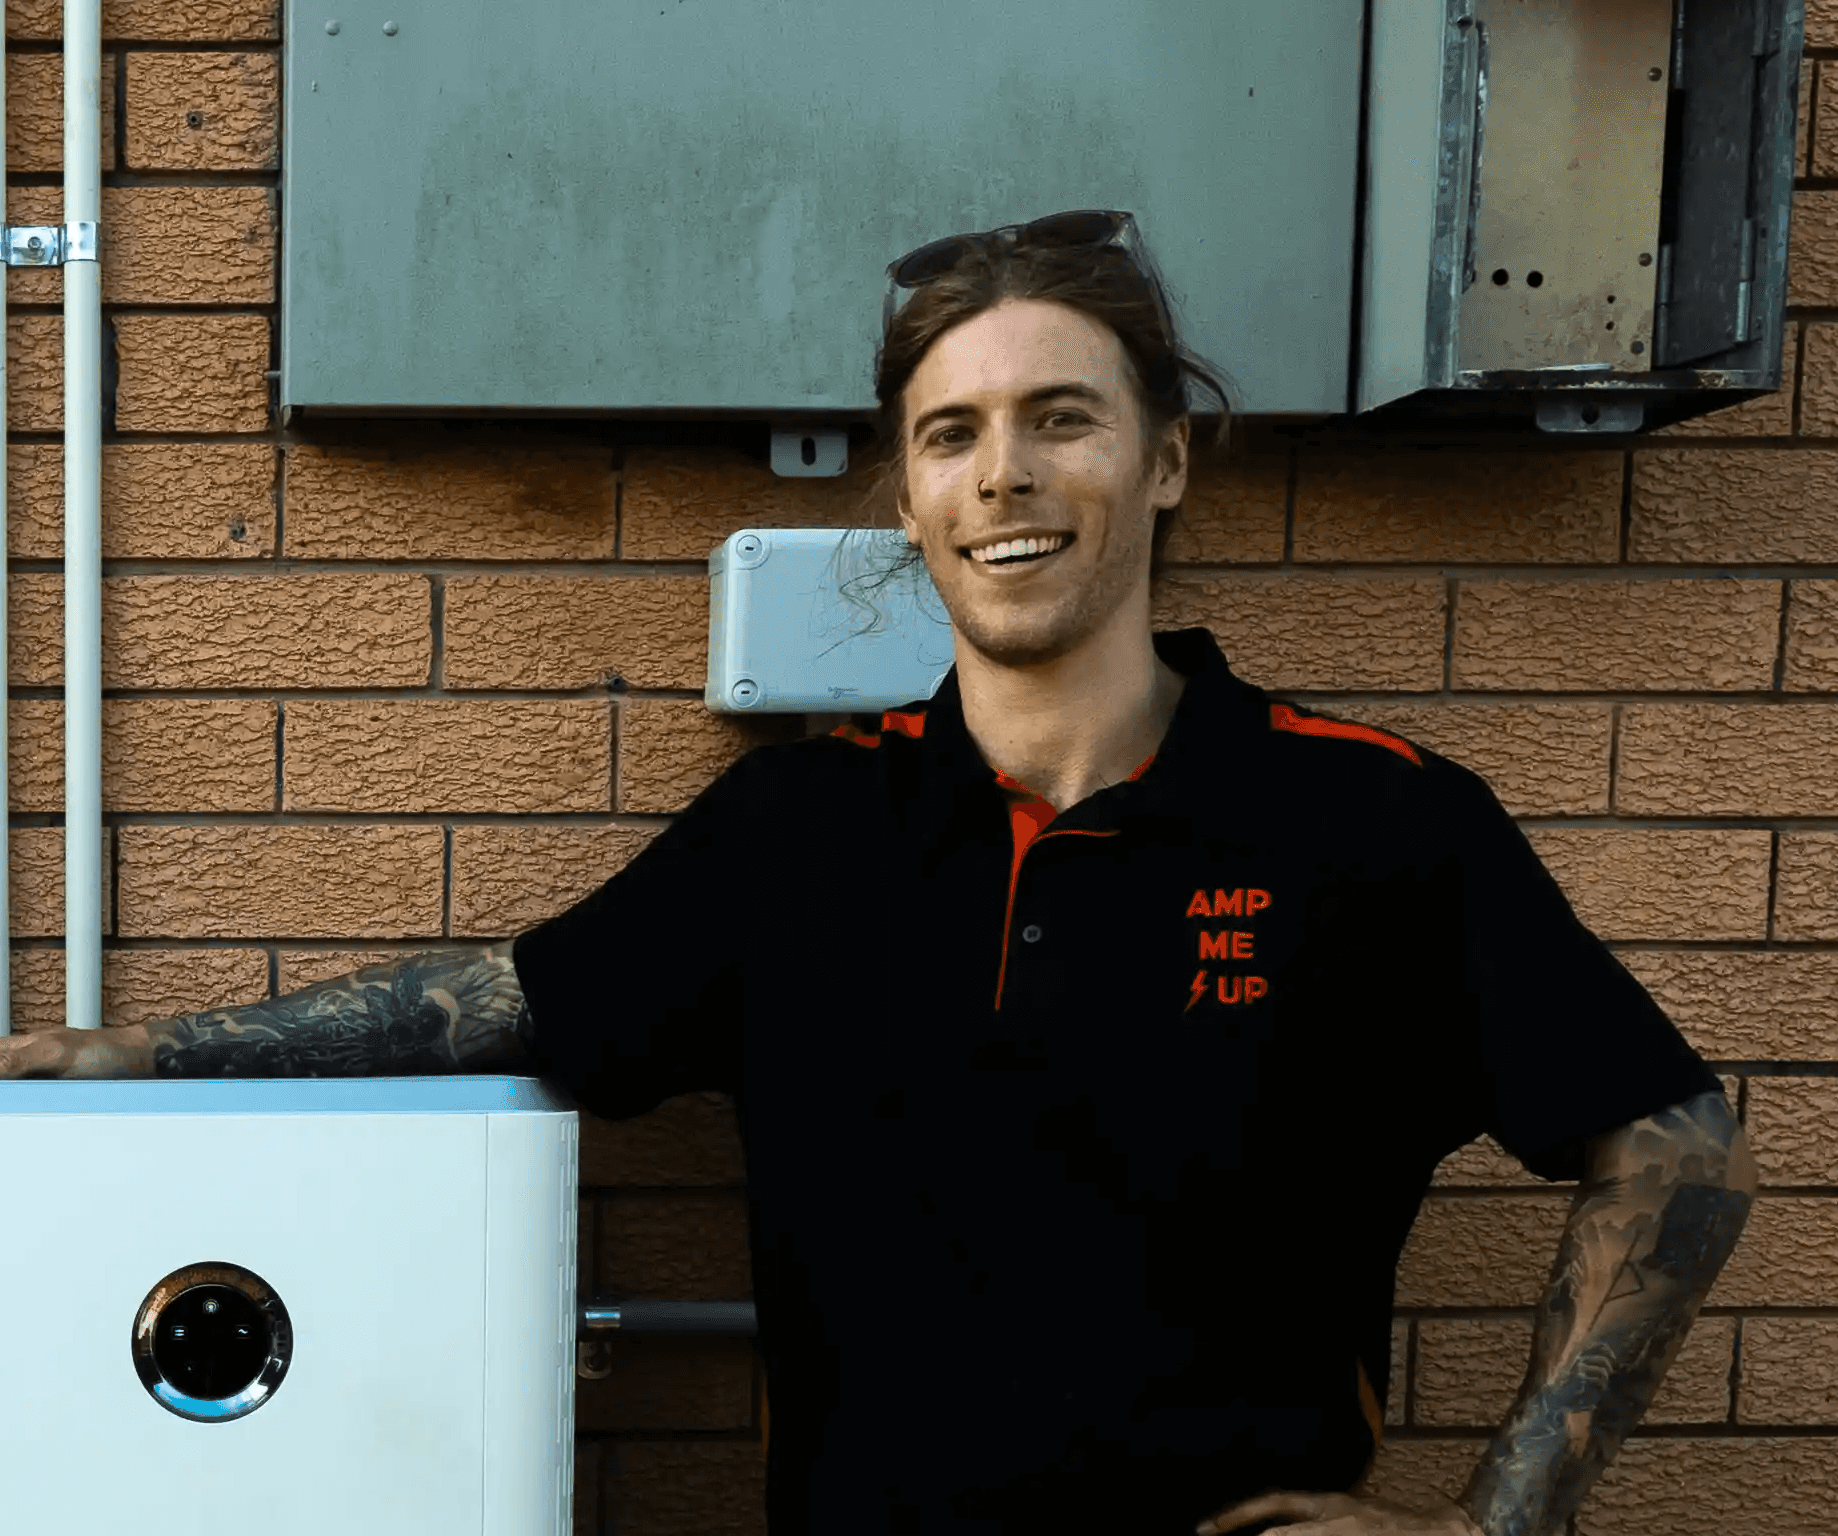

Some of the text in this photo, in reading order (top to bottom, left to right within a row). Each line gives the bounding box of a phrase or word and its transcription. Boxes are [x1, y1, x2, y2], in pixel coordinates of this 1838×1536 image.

[1186, 888, 1272, 917] AMP
[1199, 931, 1254, 960] ME
[1217, 975, 1268, 1004] UP
